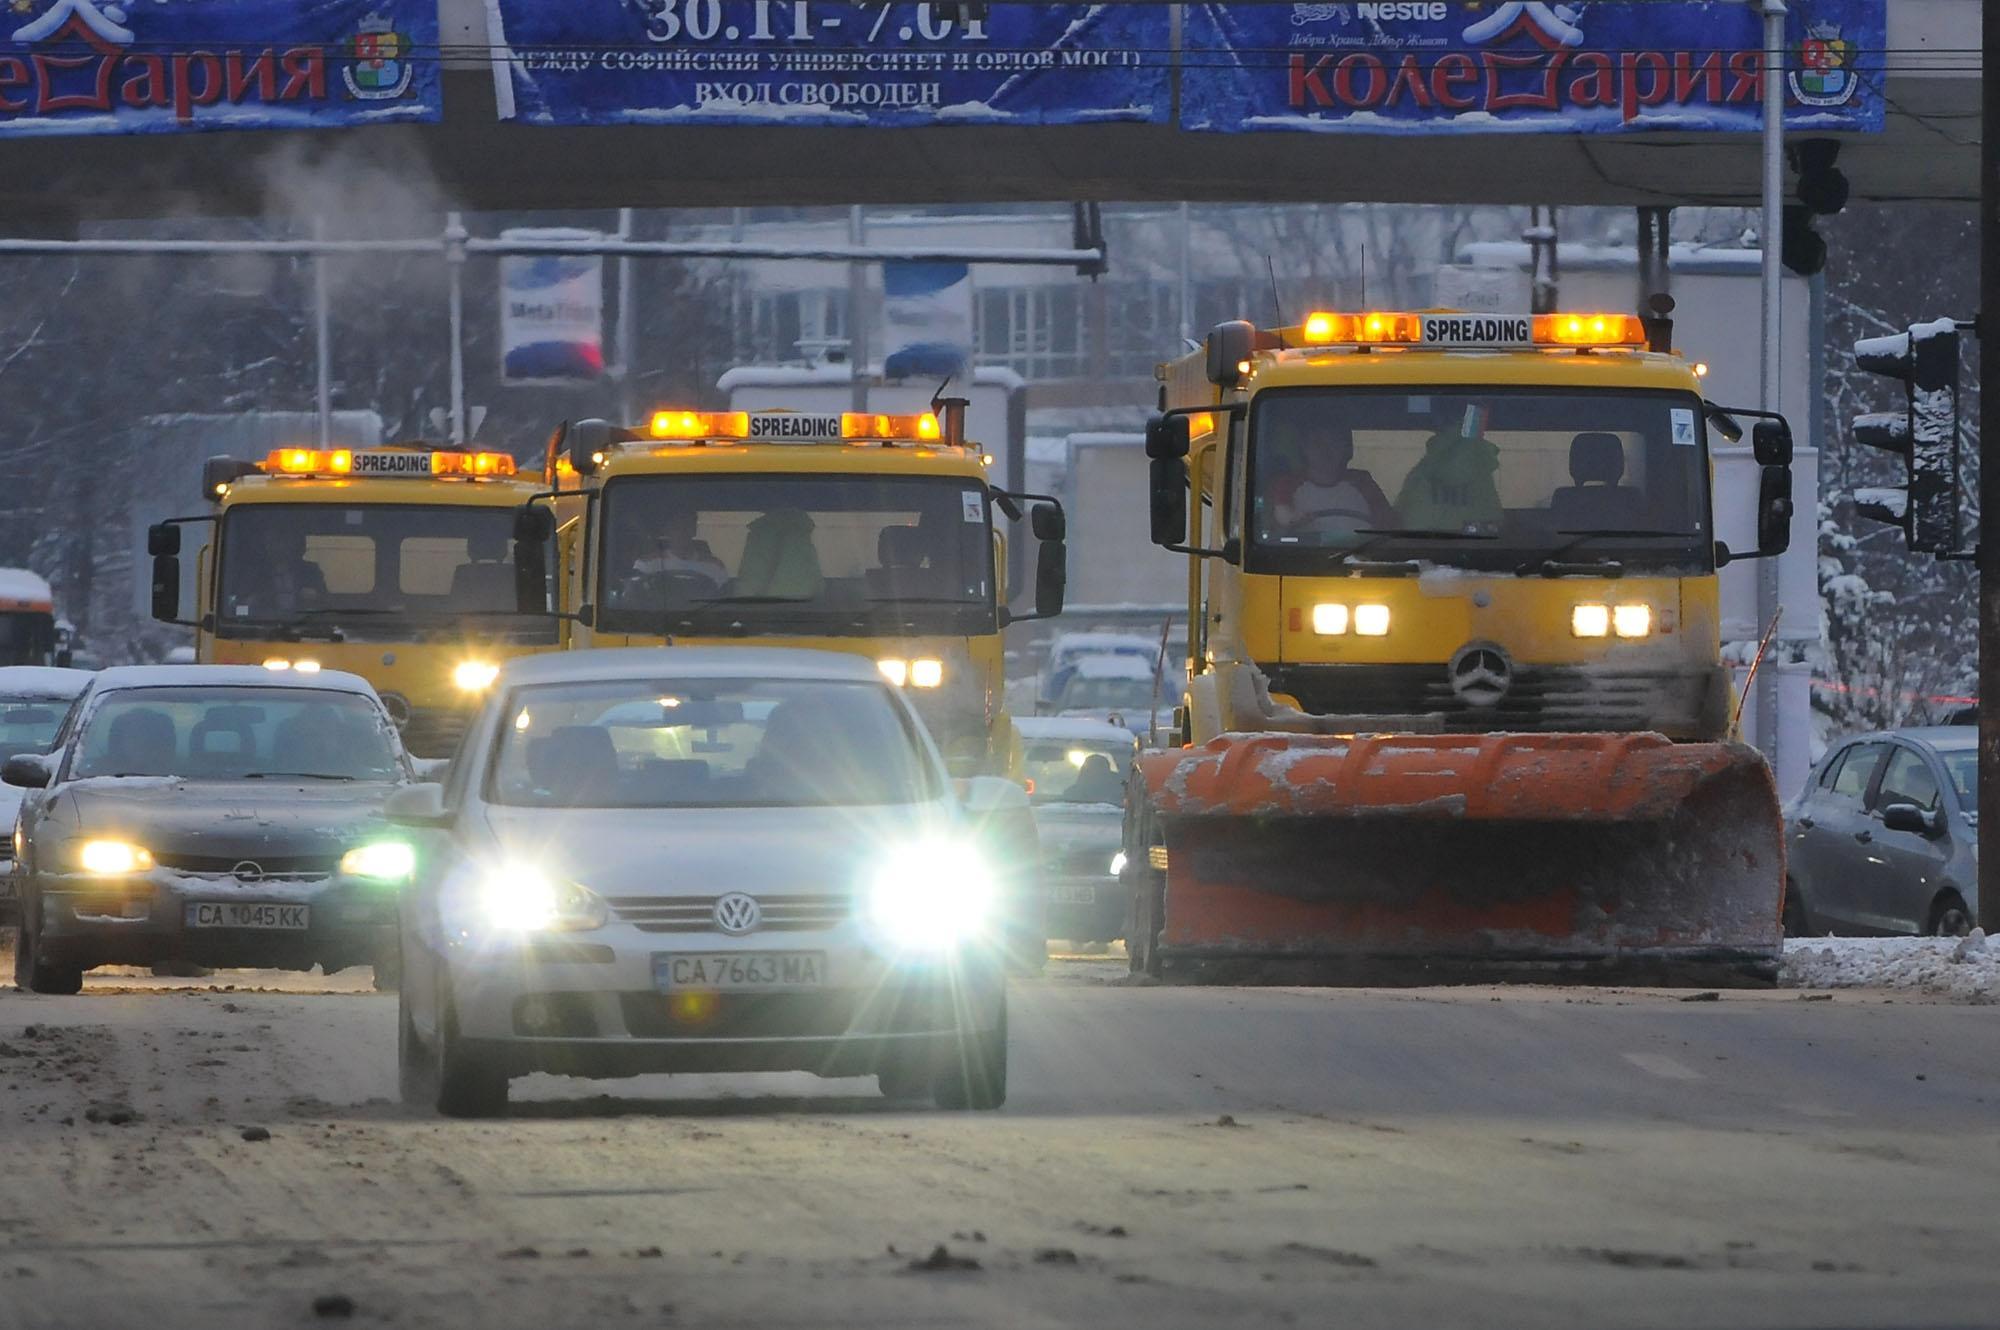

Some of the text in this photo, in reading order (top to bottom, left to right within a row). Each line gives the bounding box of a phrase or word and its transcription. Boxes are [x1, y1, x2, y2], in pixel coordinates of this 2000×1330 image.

[601, 48, 759, 71] СОФИЙСКИЯ
[768, 52, 947, 71] УНИВЕРСИТЕТ
[952, 53, 970, 70] И
[975, 51, 1054, 70] ОРЛОВ
[693, 82, 940, 109] ВХОД СВОБОДЕН
[1426, 319, 1528, 341] SPREADING
[752, 417, 838, 437] SPREADING
[354, 455, 428, 471] SPREADING
[672, 959, 707, 984] CA
[713, 959, 778, 984] 7663
